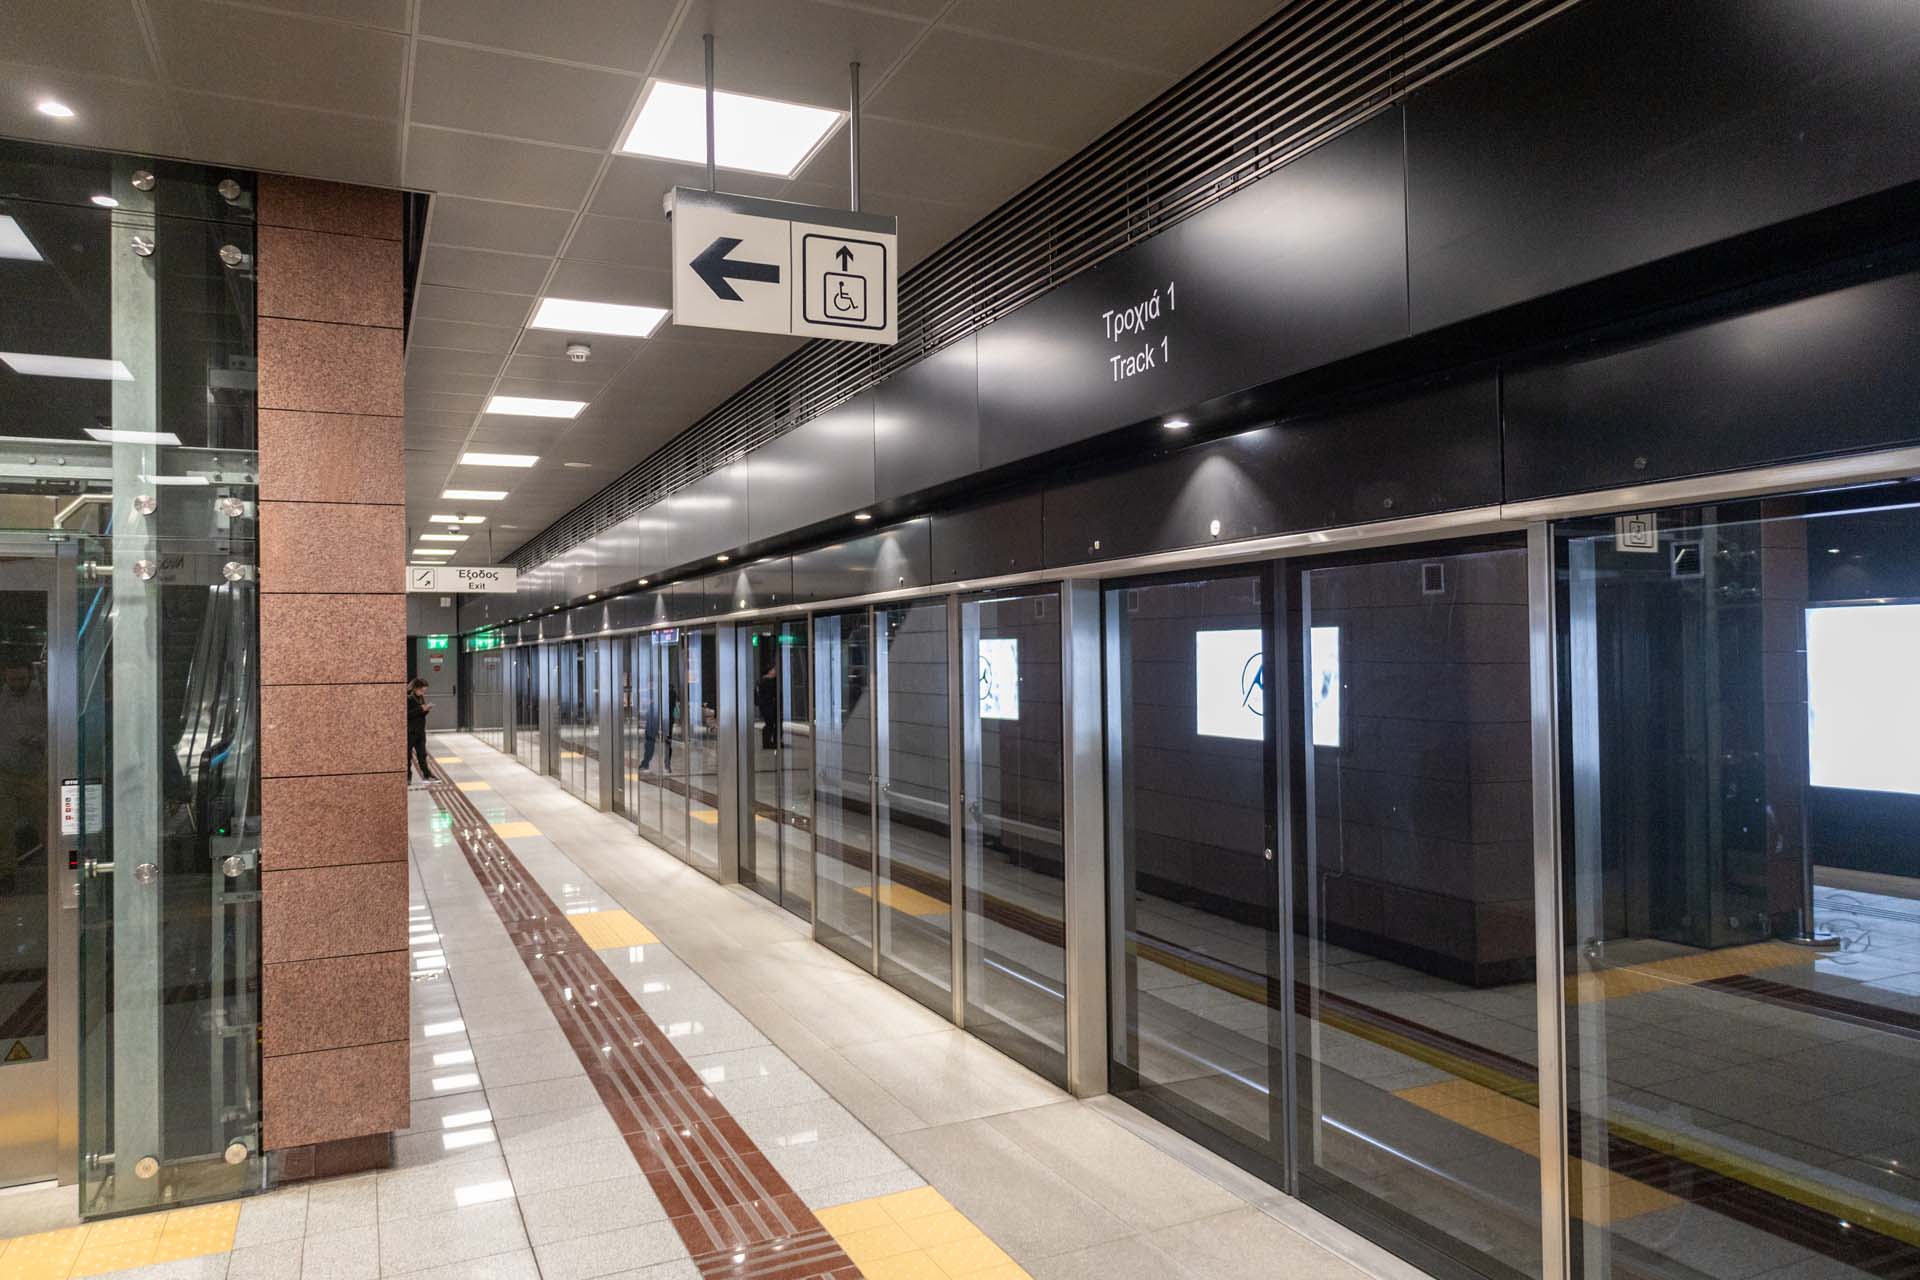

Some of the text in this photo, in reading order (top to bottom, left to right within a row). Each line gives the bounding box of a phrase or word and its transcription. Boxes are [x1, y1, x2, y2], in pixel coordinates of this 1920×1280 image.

[1102, 281, 1175, 342] Τροχιά 1
[1110, 335, 1168, 382] Track 1
[456, 569, 499, 581] Έξοδος
[468, 582, 486, 590] Exit
